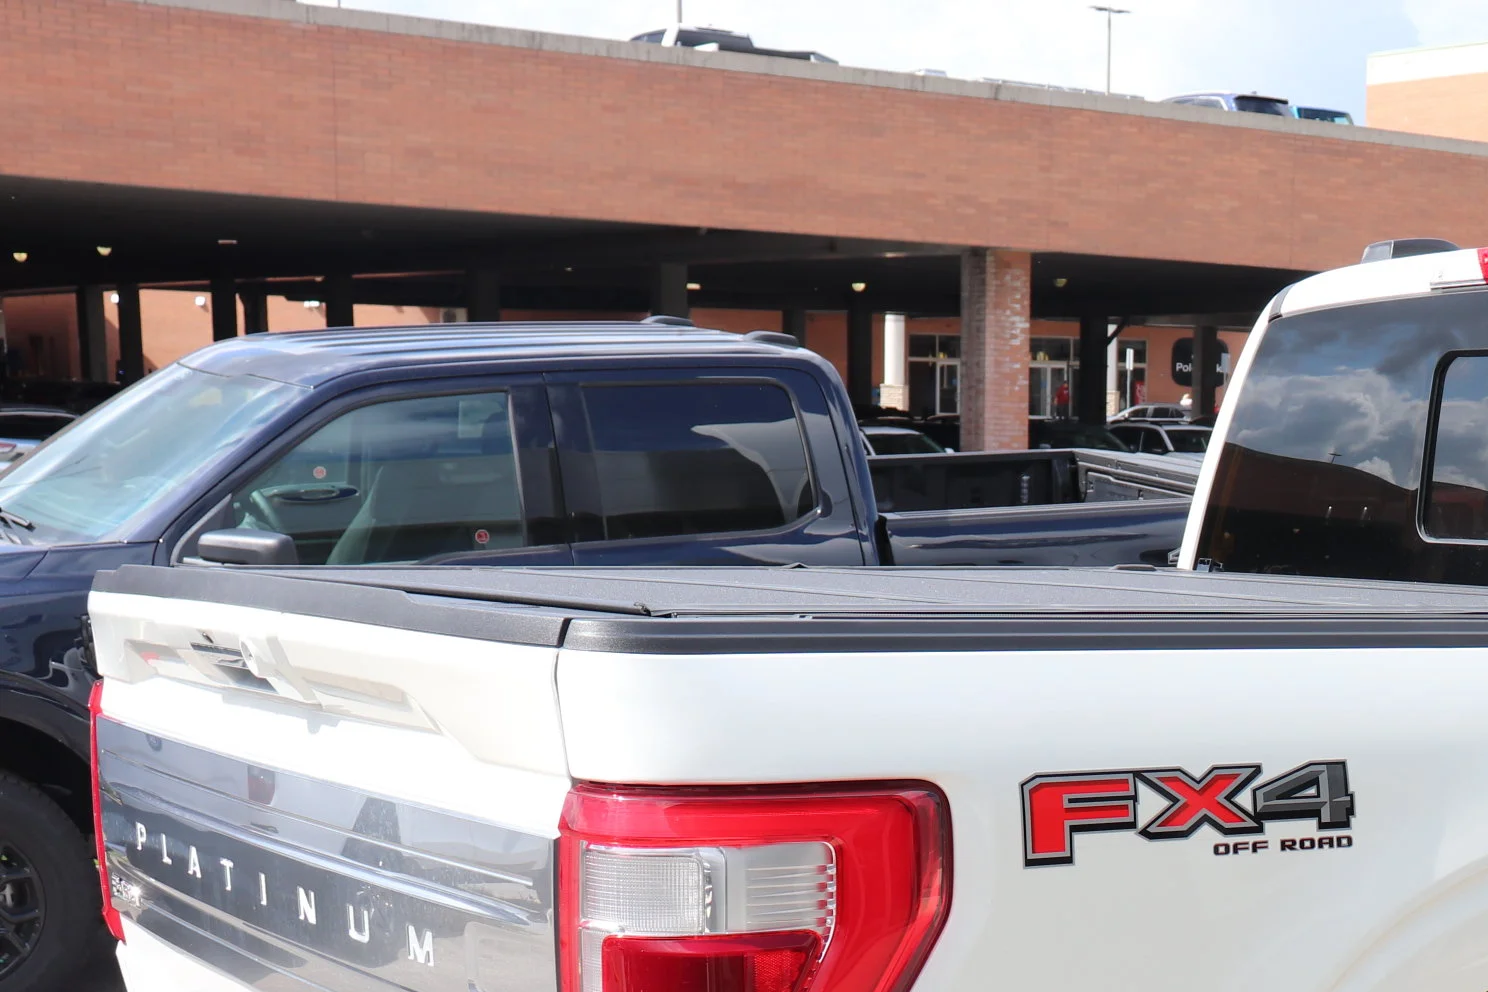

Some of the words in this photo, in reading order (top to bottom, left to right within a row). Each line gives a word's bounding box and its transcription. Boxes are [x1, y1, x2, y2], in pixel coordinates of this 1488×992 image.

[1018, 759, 1356, 869] FX4
[1213, 839, 1270, 857] OFF
[1280, 834, 1354, 853] ROAD
[135, 821, 436, 967] PLATINUM
